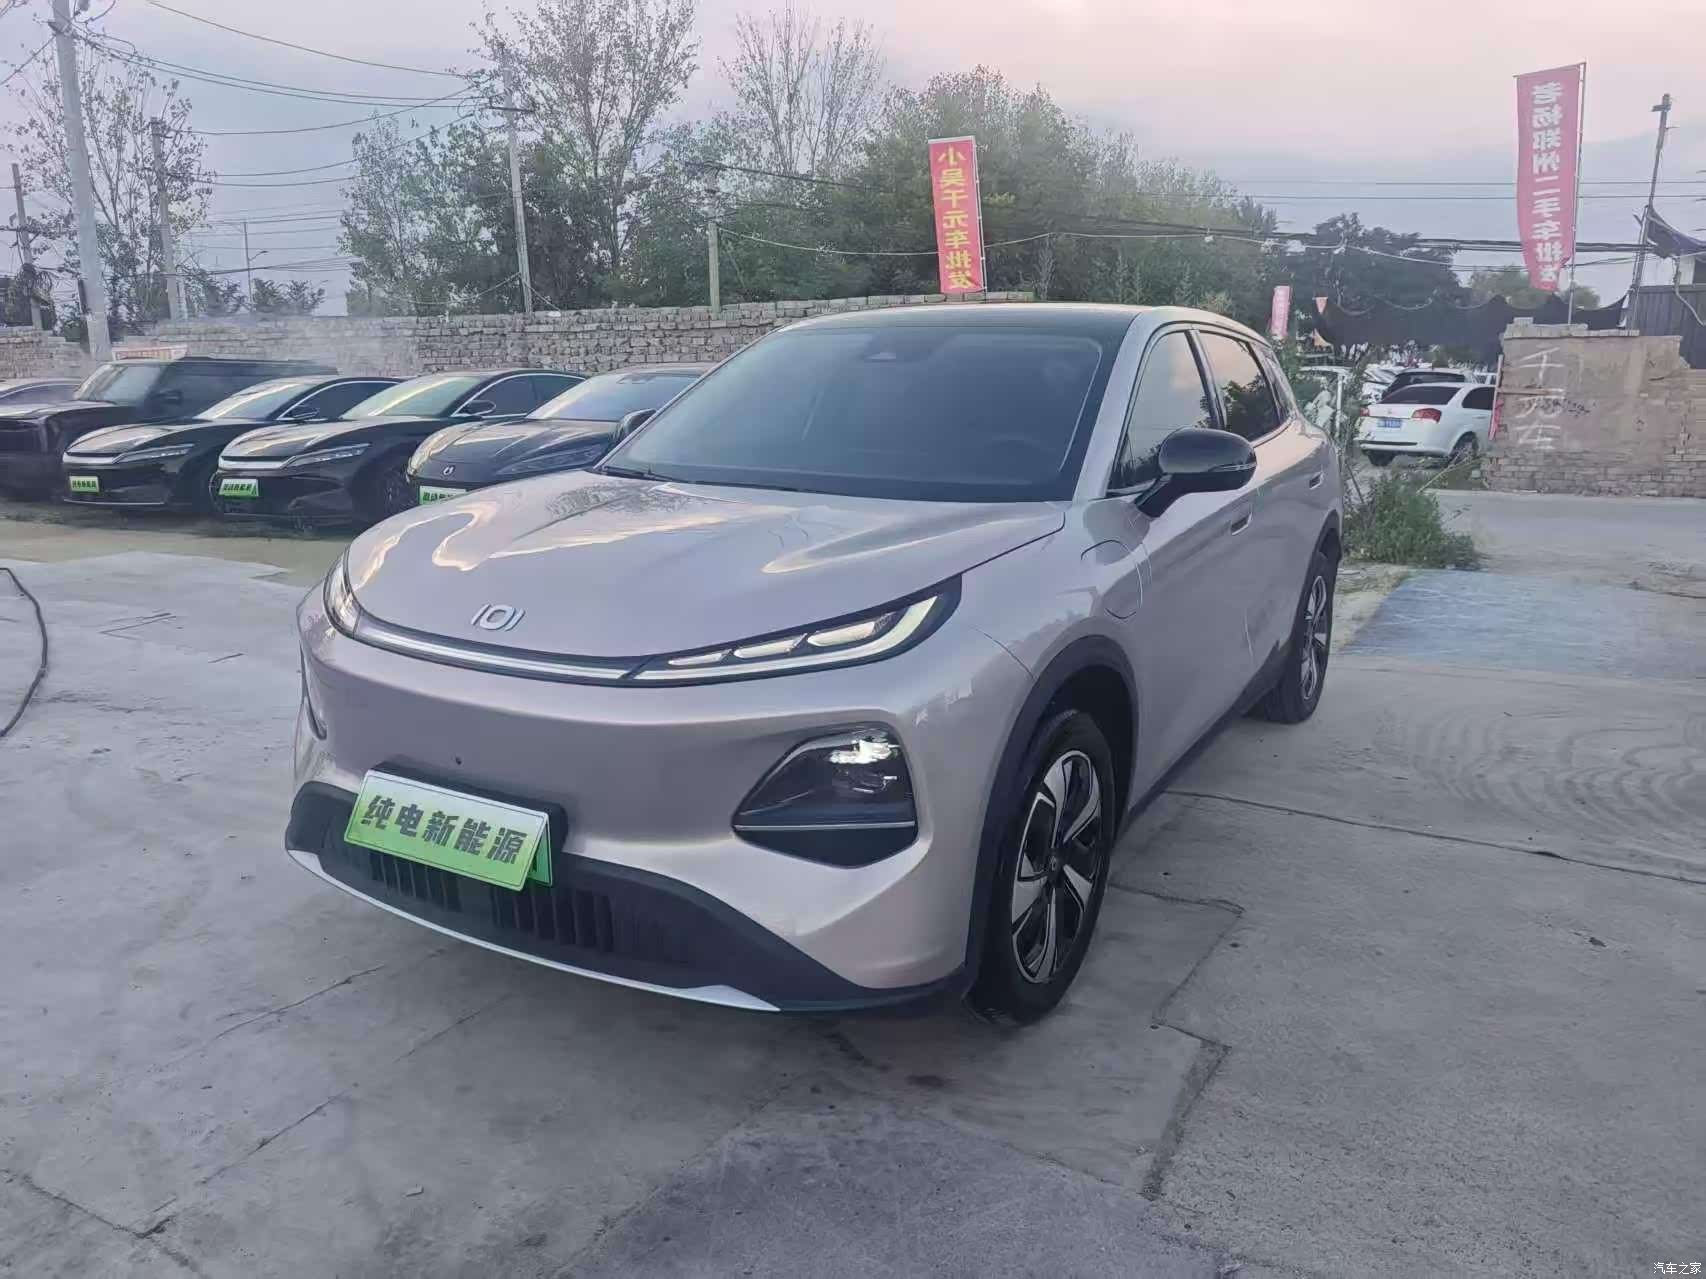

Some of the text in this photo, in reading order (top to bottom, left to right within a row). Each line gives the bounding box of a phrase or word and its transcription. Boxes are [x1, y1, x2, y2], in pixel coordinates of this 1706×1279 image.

[360, 794, 528, 865] 纯电新能源
